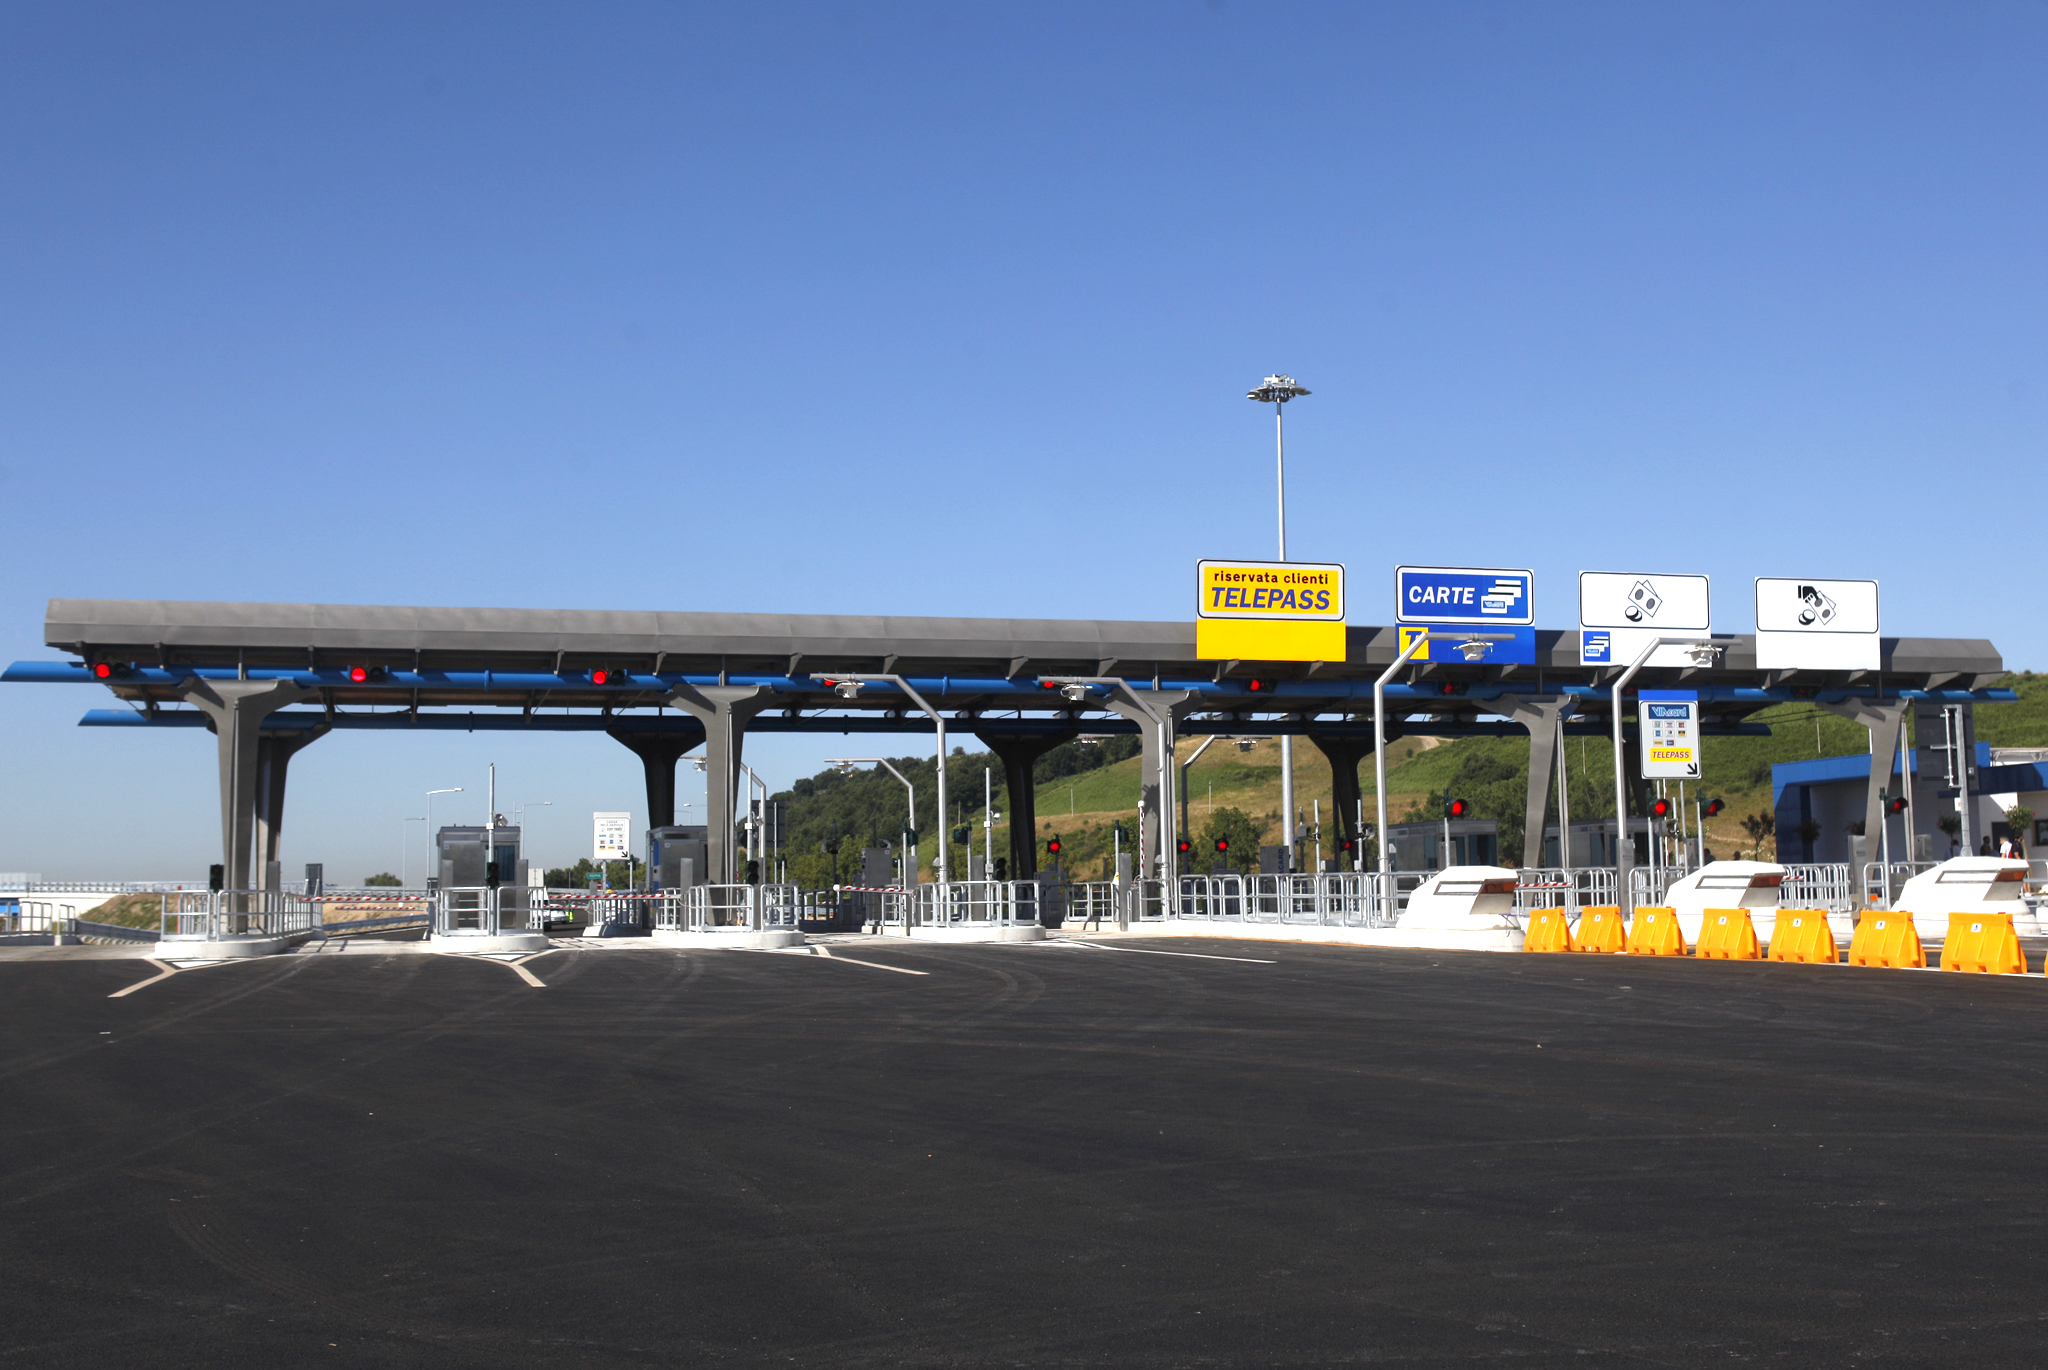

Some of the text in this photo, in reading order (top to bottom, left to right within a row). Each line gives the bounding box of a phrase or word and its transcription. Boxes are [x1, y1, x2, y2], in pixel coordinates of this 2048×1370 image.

[1214, 570, 1329, 585] riservata clienti
[1211, 586, 1331, 610] TELEPASS
[1408, 585, 1476, 604] CARTE
[1653, 751, 1690, 759] TELEPASS
